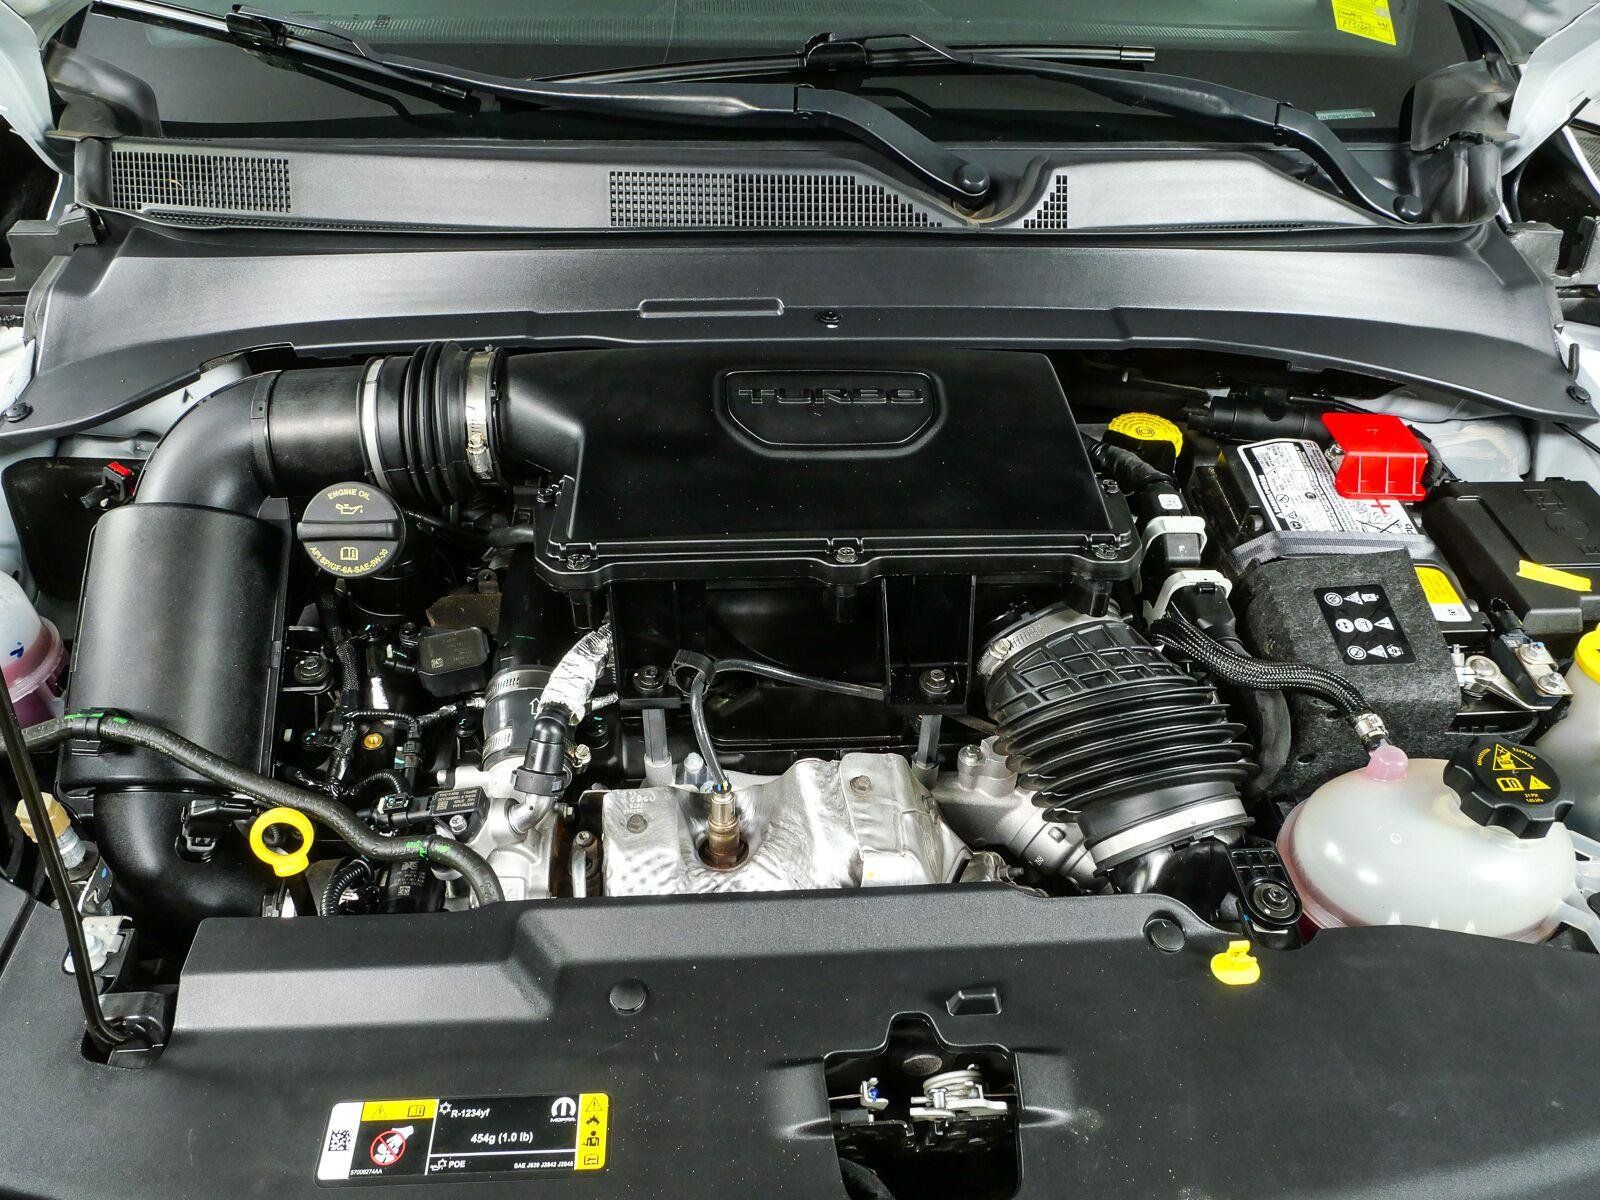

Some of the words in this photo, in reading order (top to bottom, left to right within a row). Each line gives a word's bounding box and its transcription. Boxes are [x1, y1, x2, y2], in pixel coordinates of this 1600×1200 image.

[738, 388, 924, 404] TURBO
[327, 488, 357, 500] ENGINE
[358, 490, 370, 501] OIL
[310, 546, 321, 560] API
[450, 1108, 490, 1119] R-1234yf
[470, 1133, 496, 1145] 454g
[498, 1132, 517, 1144] (1.0
[519, 1131, 534, 1143] lb)
[448, 1159, 466, 1168] POE
